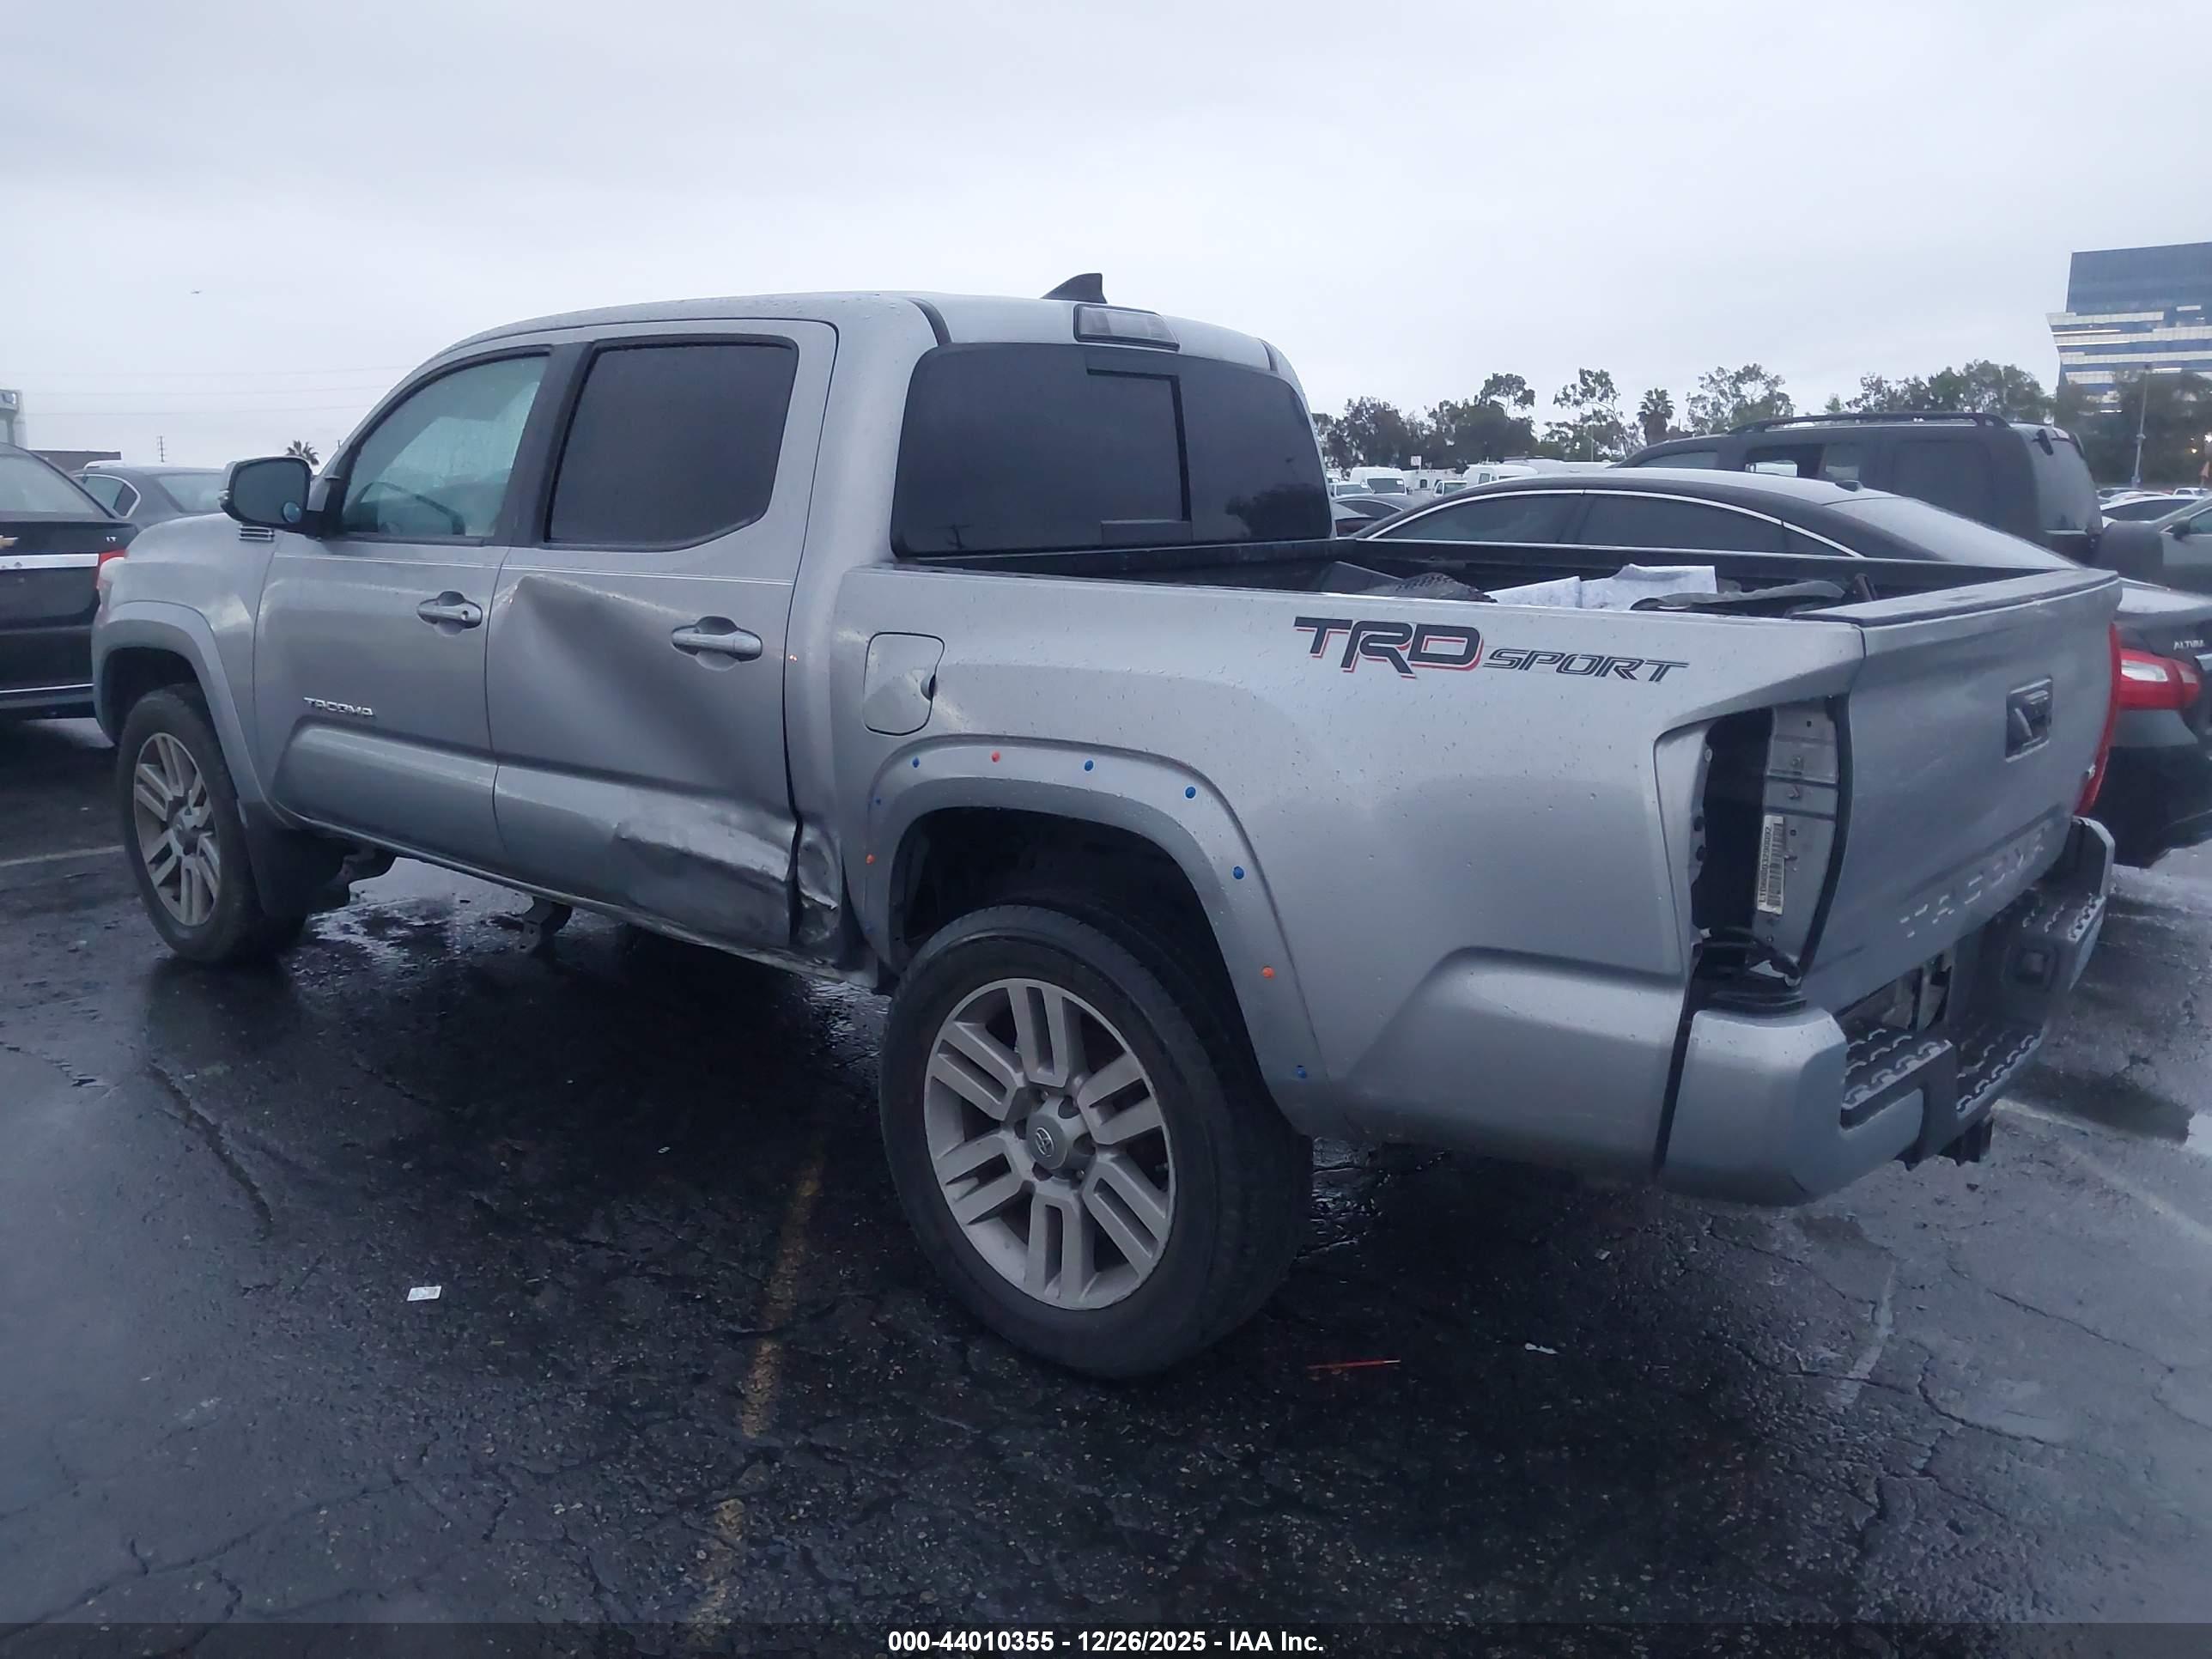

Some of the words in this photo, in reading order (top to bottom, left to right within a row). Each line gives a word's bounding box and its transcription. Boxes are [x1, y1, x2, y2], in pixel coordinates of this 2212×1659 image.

[1294, 617, 1485, 679] TRD
[1483, 648, 1690, 684] SPORT
[303, 696, 374, 716] TACOMA
